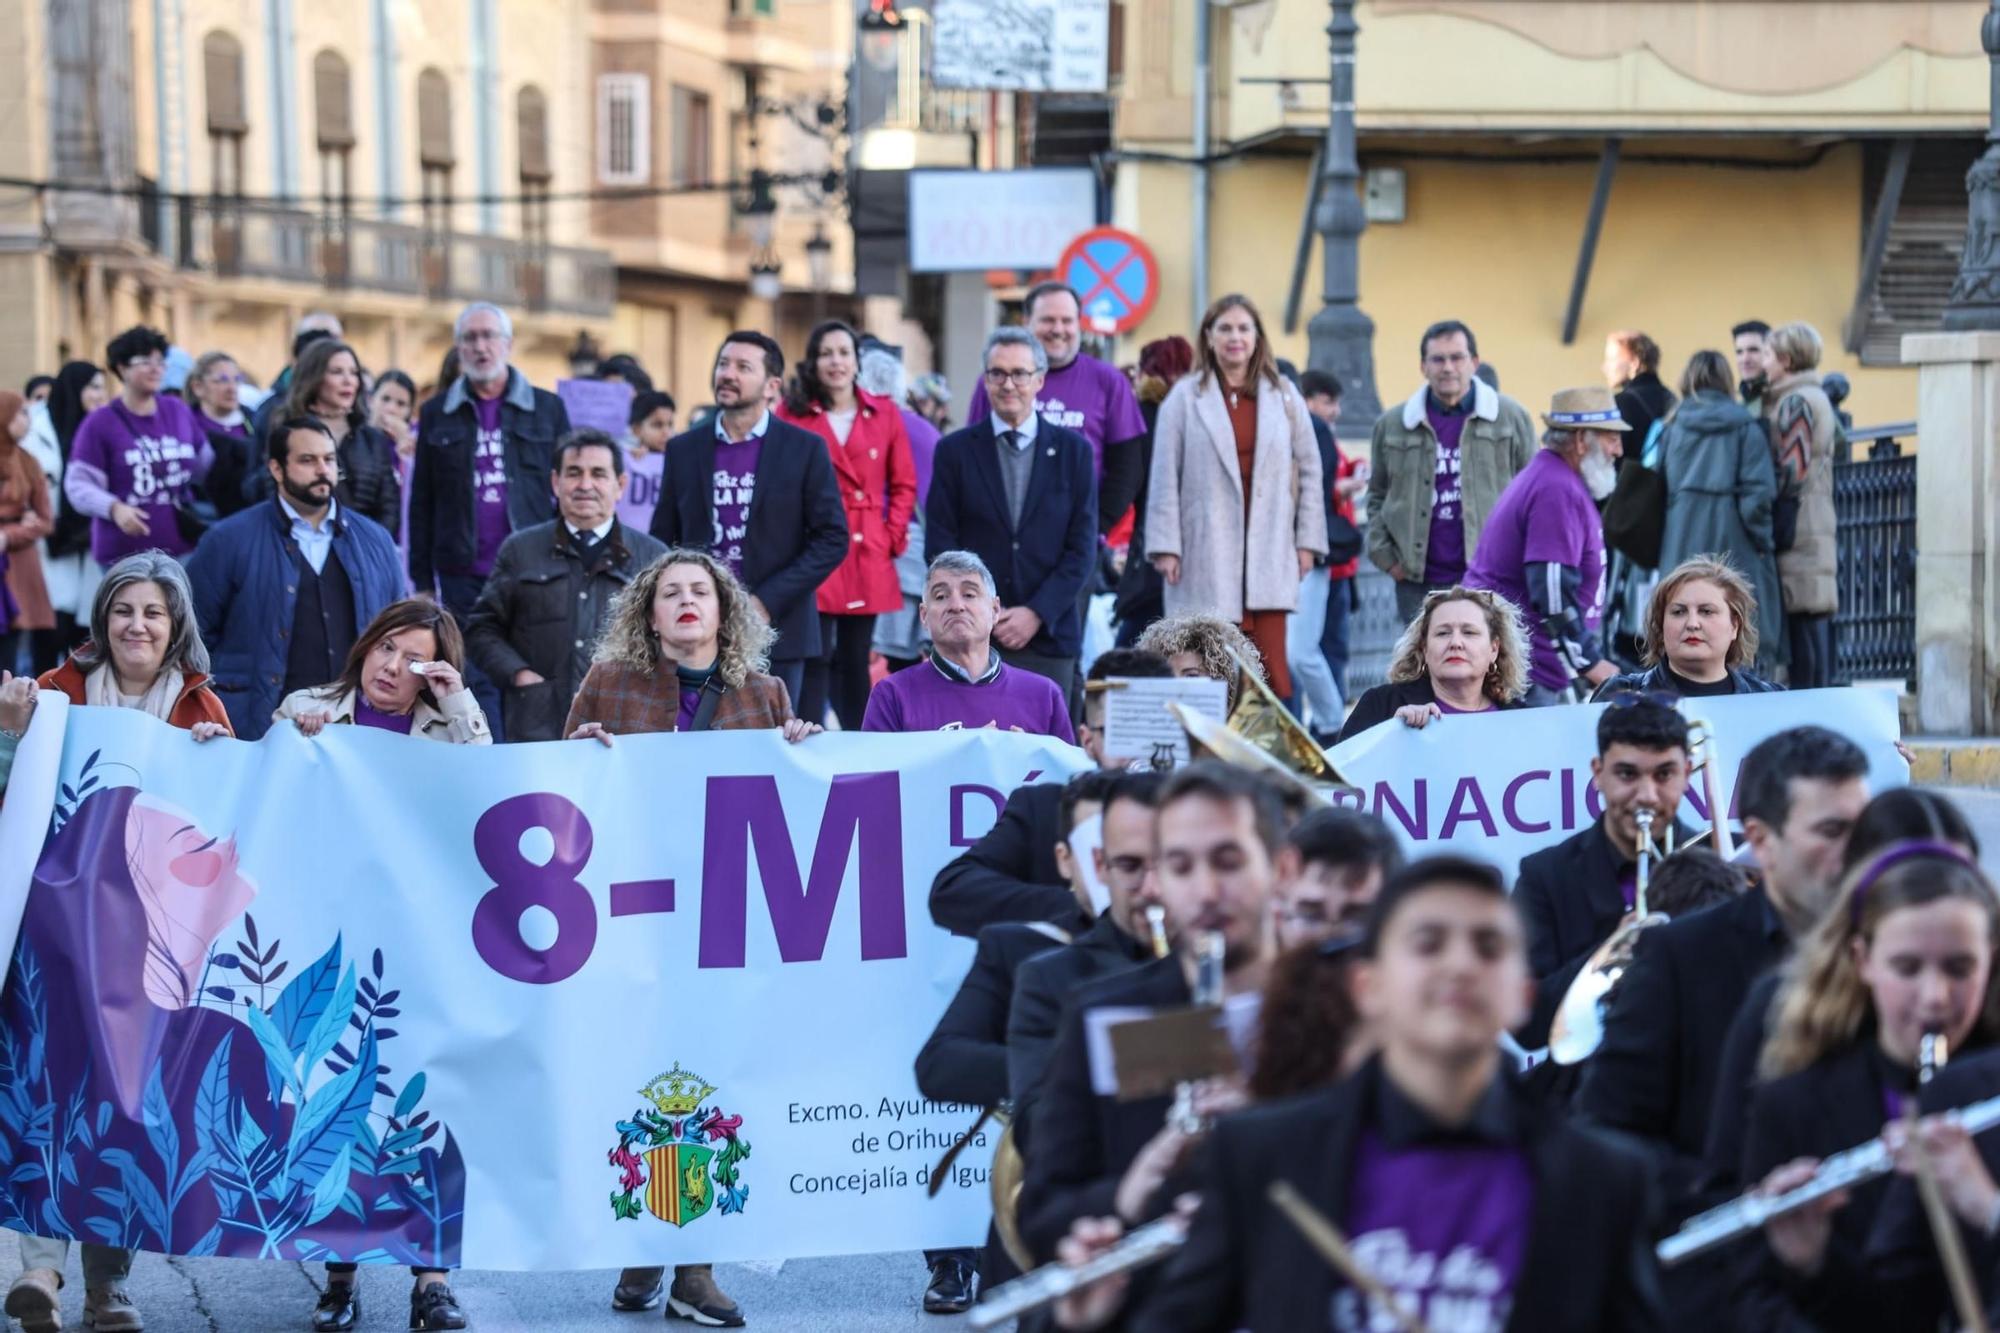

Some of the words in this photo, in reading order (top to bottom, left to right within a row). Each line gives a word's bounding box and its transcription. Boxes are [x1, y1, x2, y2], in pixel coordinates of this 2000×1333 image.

[472, 770, 907, 985] 8-M
[789, 1102, 869, 1124] Excmo.
[852, 1132, 879, 1153] de
[790, 1165, 908, 1195] Concejalía
[953, 1162, 992, 1189] Igu
